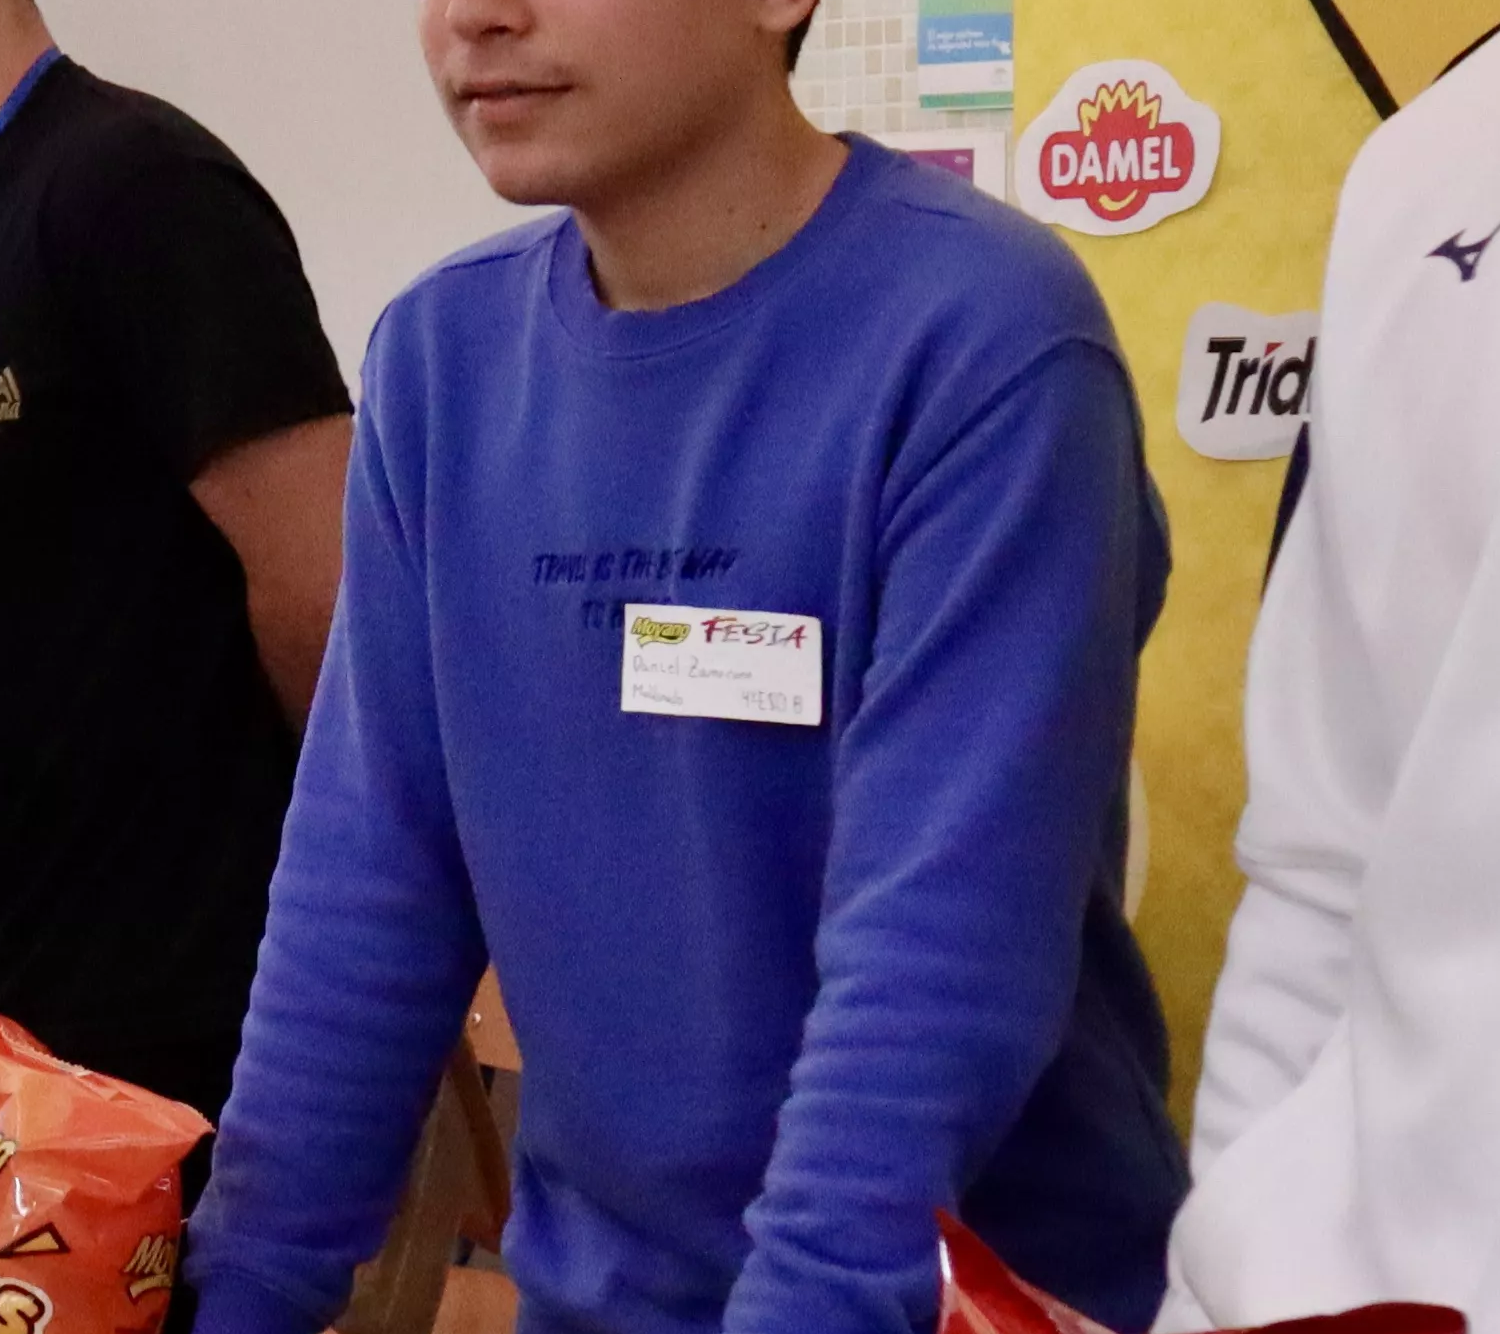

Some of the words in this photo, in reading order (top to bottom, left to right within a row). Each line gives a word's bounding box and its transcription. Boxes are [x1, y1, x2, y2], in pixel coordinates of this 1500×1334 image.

[1050, 133, 1183, 190] DAMEL
[1200, 336, 1317, 423] Trid
[701, 616, 808, 649] FESIA
